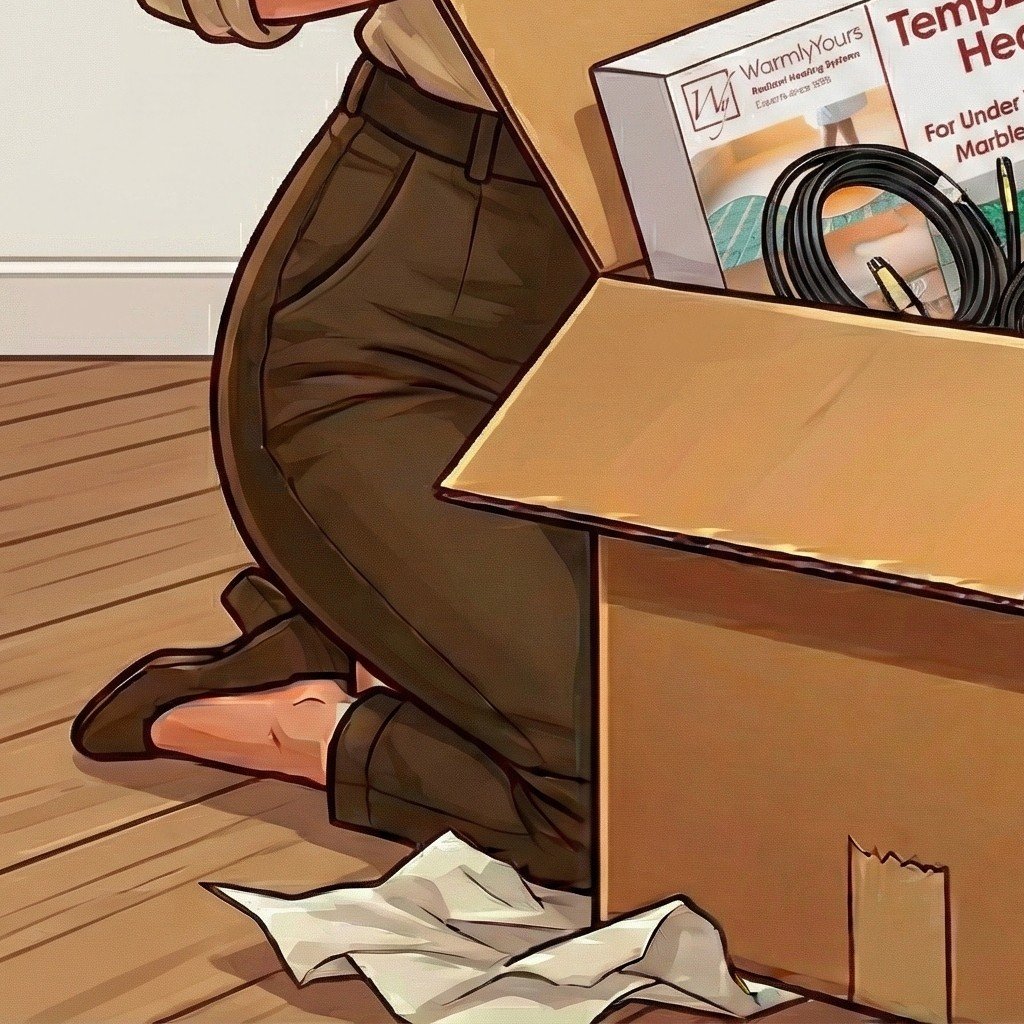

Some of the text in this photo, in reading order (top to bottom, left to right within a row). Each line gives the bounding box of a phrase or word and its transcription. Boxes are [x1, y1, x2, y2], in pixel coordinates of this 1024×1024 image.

[739, 26, 863, 80] WarmlyYours
[924, 120, 955, 143] For
[959, 96, 1020, 129] Under
